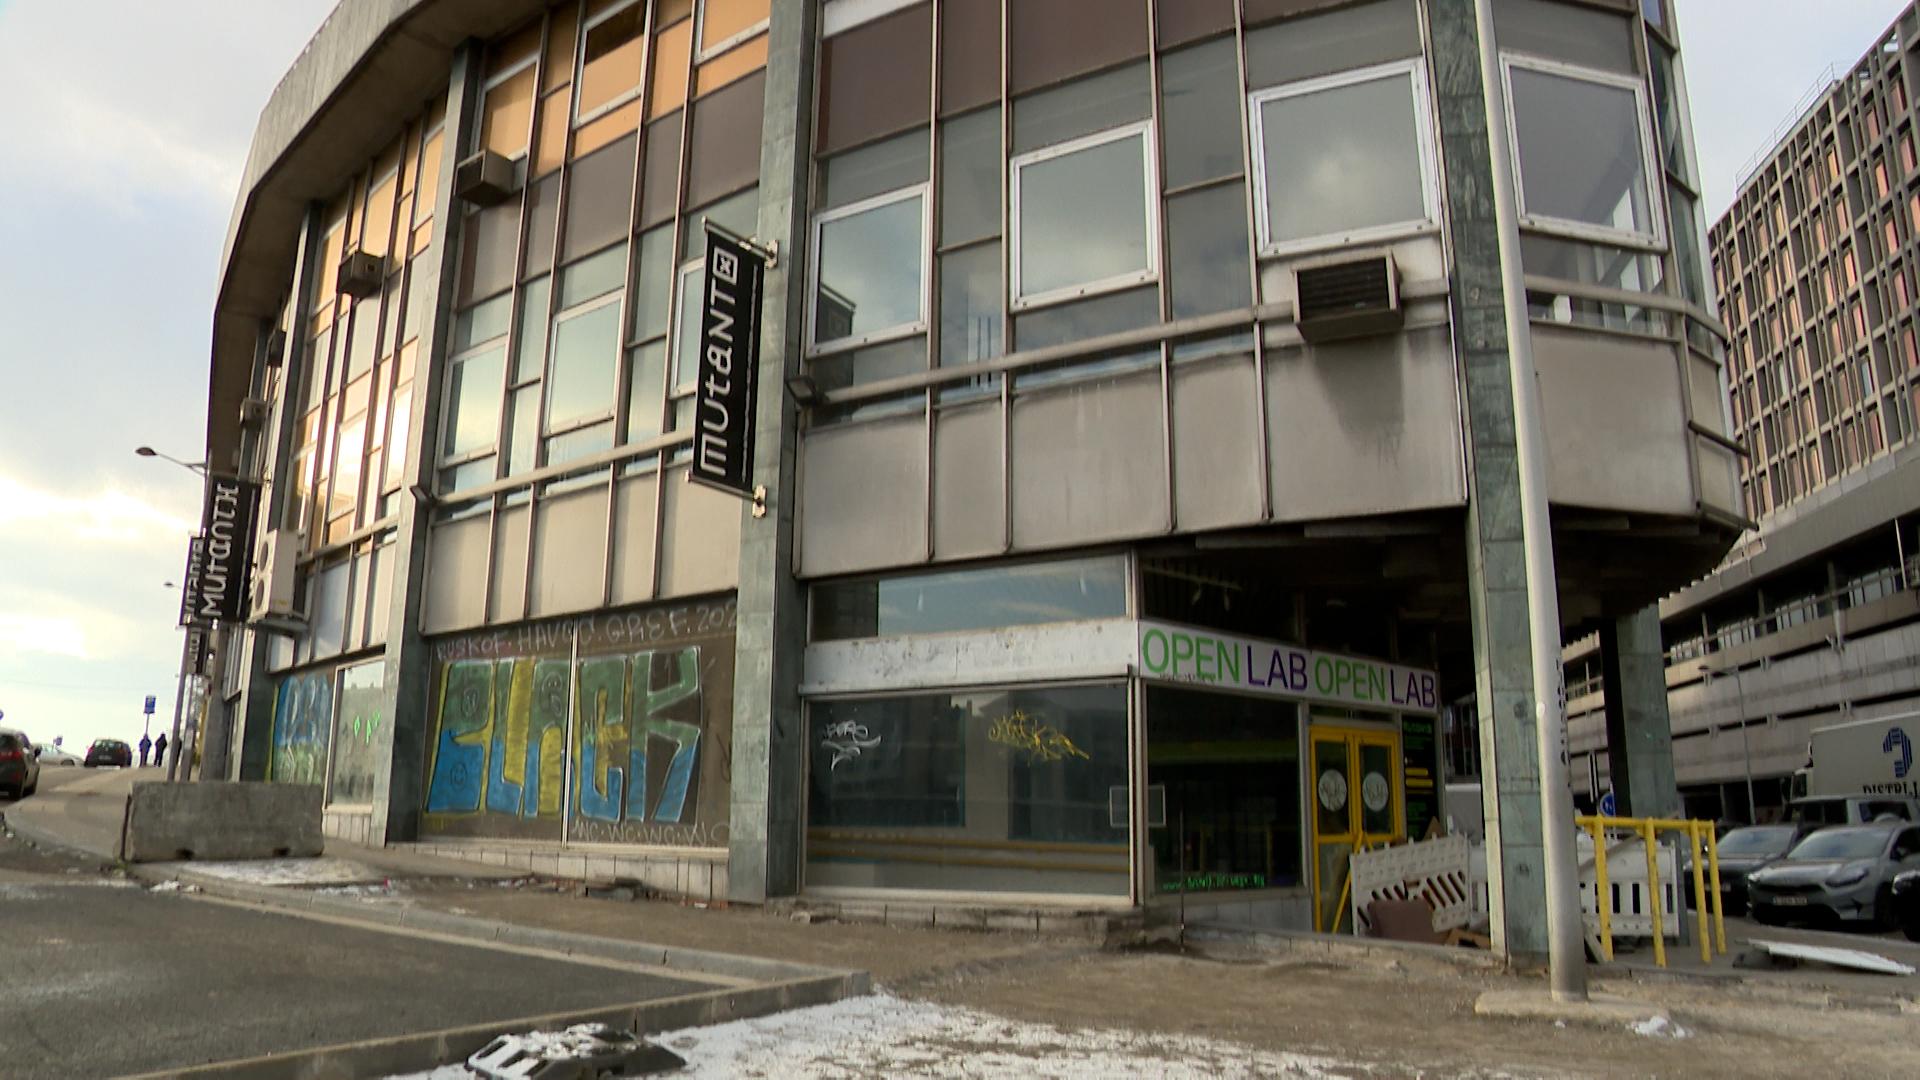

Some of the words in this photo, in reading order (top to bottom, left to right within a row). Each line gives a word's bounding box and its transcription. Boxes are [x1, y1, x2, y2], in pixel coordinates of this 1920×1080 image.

[1142, 628, 1240, 684] OPEN
[1246, 645, 1308, 691] LAB
[1314, 656, 1386, 702] OPEN
[1390, 669, 1436, 709] LAB
